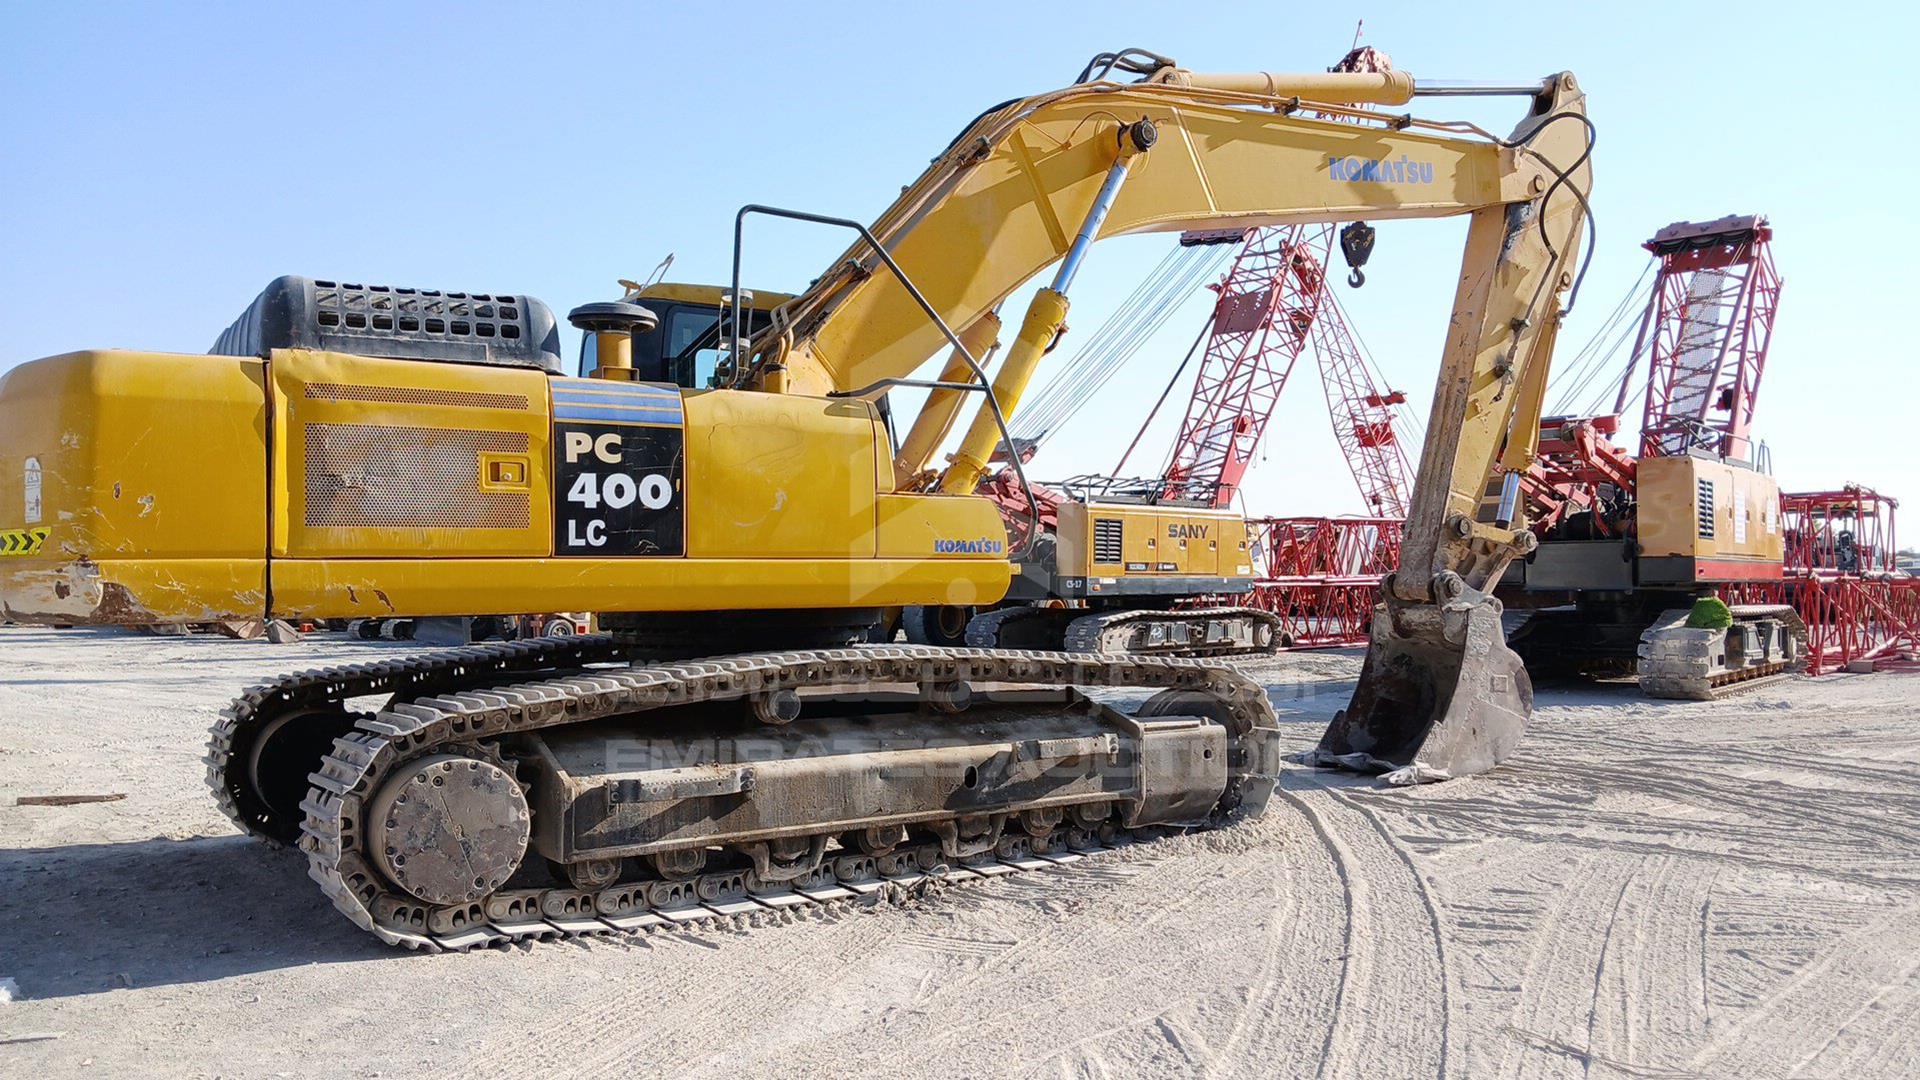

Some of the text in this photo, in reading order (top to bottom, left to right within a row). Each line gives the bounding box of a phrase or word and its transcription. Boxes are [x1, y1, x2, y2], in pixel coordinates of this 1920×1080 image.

[1329, 154, 1433, 184] KOMATSU
[565, 431, 622, 464] PC
[567, 472, 673, 510] 400
[568, 519, 607, 547] LC
[934, 537, 1002, 553] KOMATSU
[1168, 523, 1209, 539] SANY
